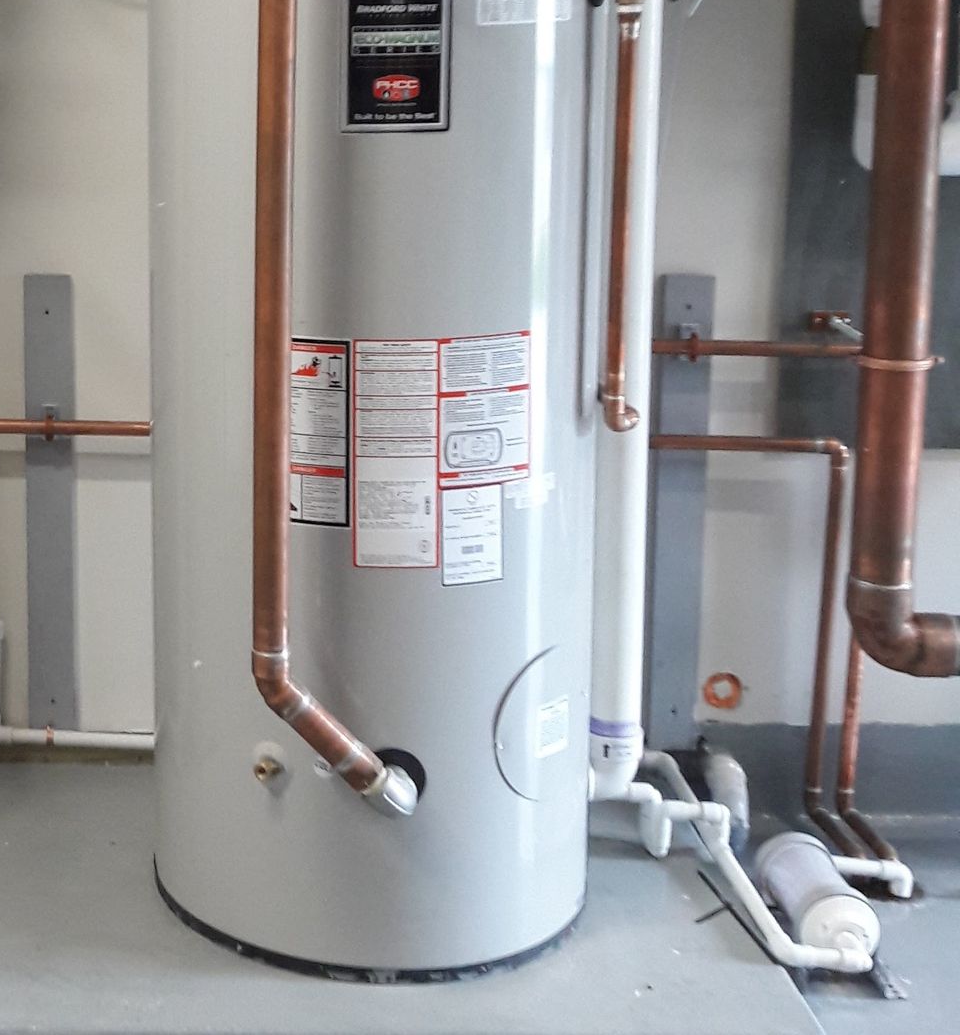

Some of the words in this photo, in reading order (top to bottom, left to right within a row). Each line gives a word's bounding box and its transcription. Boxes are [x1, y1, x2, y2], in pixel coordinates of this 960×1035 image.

[356, 4, 407, 13] BRADFORD
[408, 3, 439, 13] WHITE
[415, 112, 435, 120] Best
